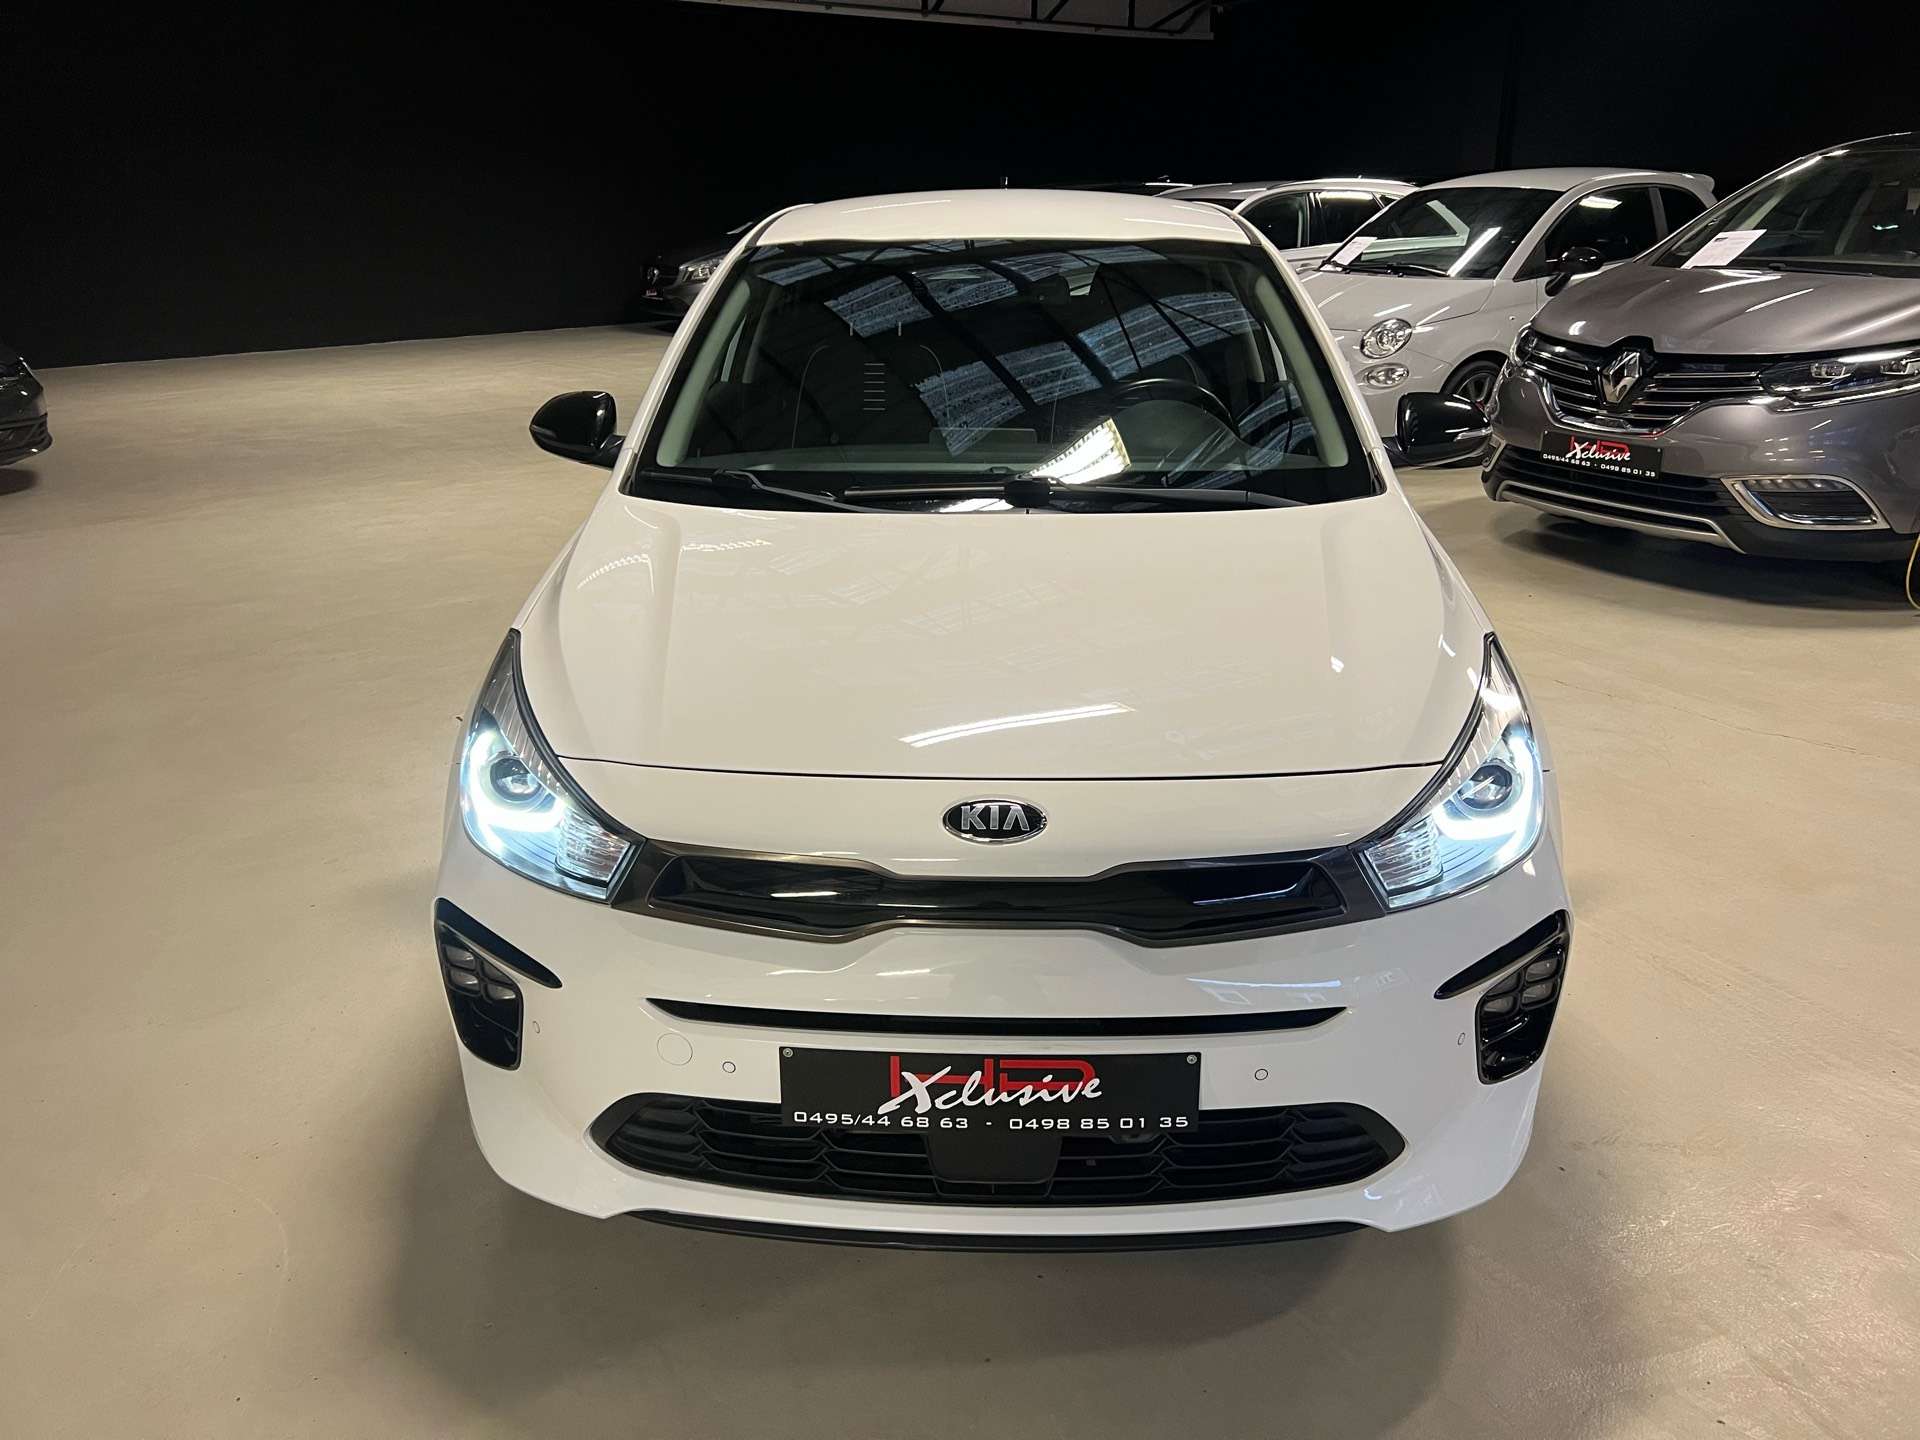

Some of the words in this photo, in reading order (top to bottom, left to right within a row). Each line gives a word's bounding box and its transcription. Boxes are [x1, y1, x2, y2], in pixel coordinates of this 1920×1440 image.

[1565, 441, 1631, 461] Xclusive
[961, 804, 1030, 831] KIA
[877, 1065, 1103, 1115] Xclusive
[793, 1111, 891, 1127] 0495/44
[900, 1116, 930, 1128] 68
[939, 1117, 968, 1129] 63
[1009, 1118, 1070, 1130] 0498
[1080, 1118, 1110, 1130] 85
[1119, 1117, 1145, 1129] 01
[1159, 1116, 1189, 1128] 35
